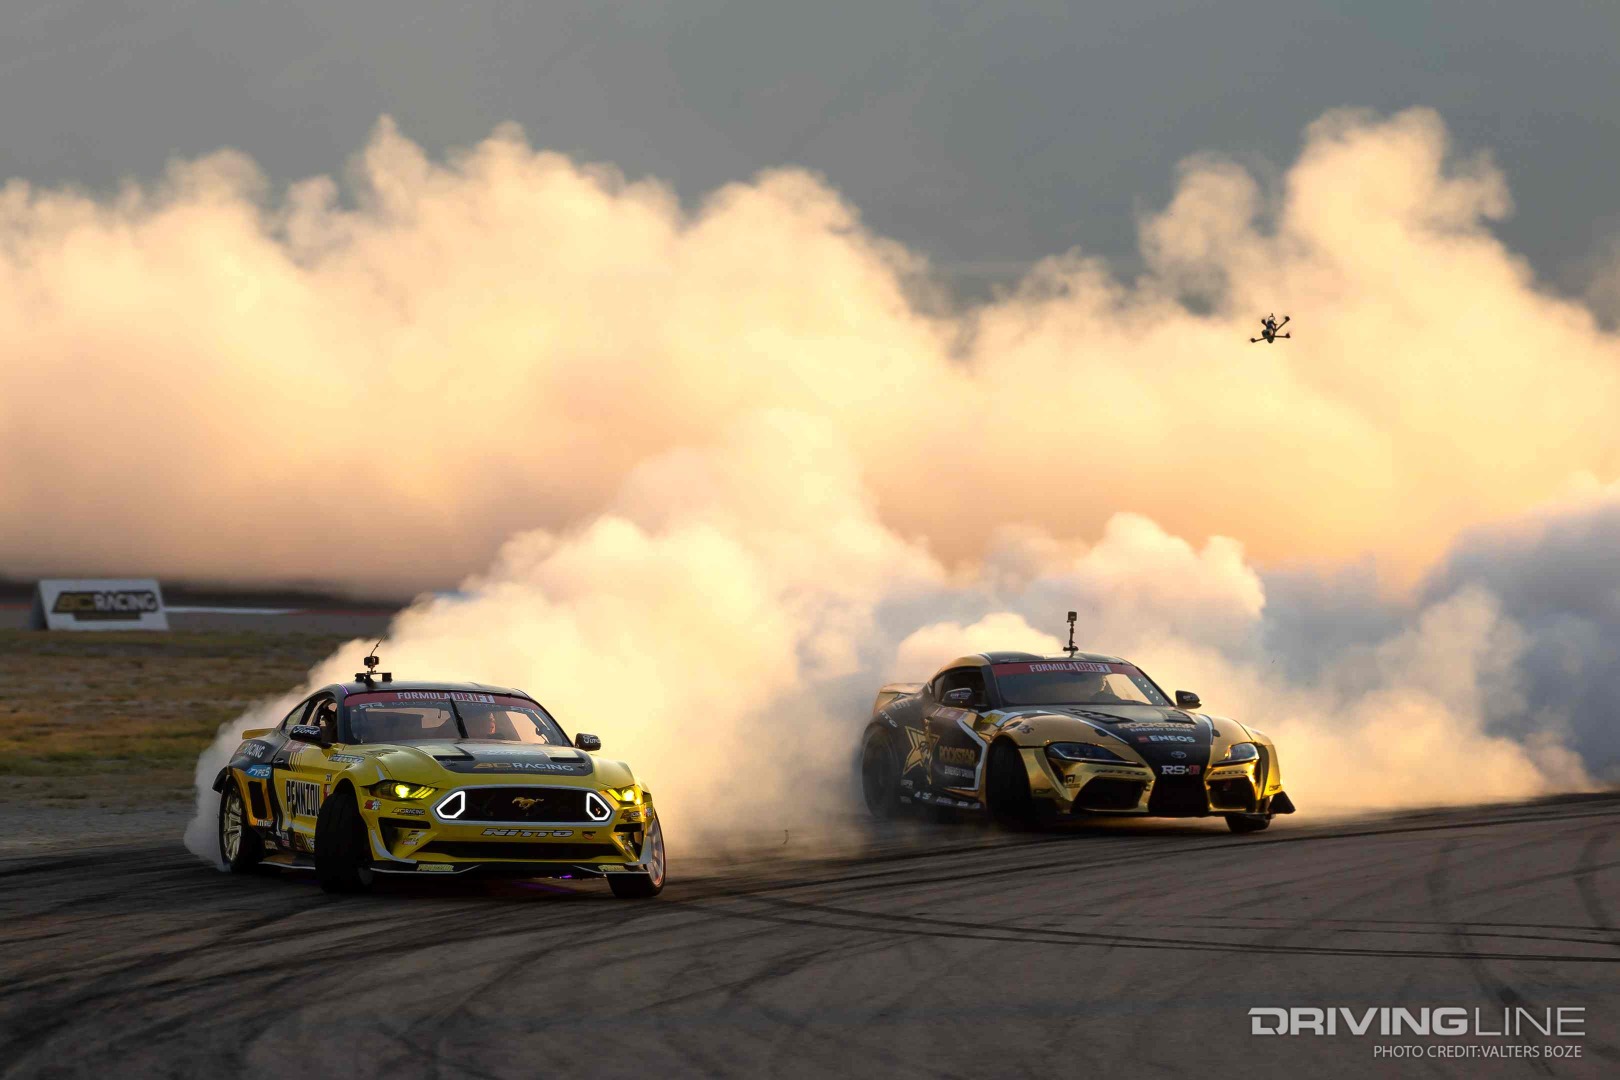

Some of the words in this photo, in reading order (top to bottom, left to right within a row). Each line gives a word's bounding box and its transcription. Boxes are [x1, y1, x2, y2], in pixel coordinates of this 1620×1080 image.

[1030, 662, 1075, 673] FORMULA
[1075, 661, 1113, 673] DRIFT
[397, 692, 450, 701] FORMULA
[1149, 735, 1195, 743] ENEOS
[512, 763, 574, 771] RACING
[481, 828, 574, 837] NITTO
